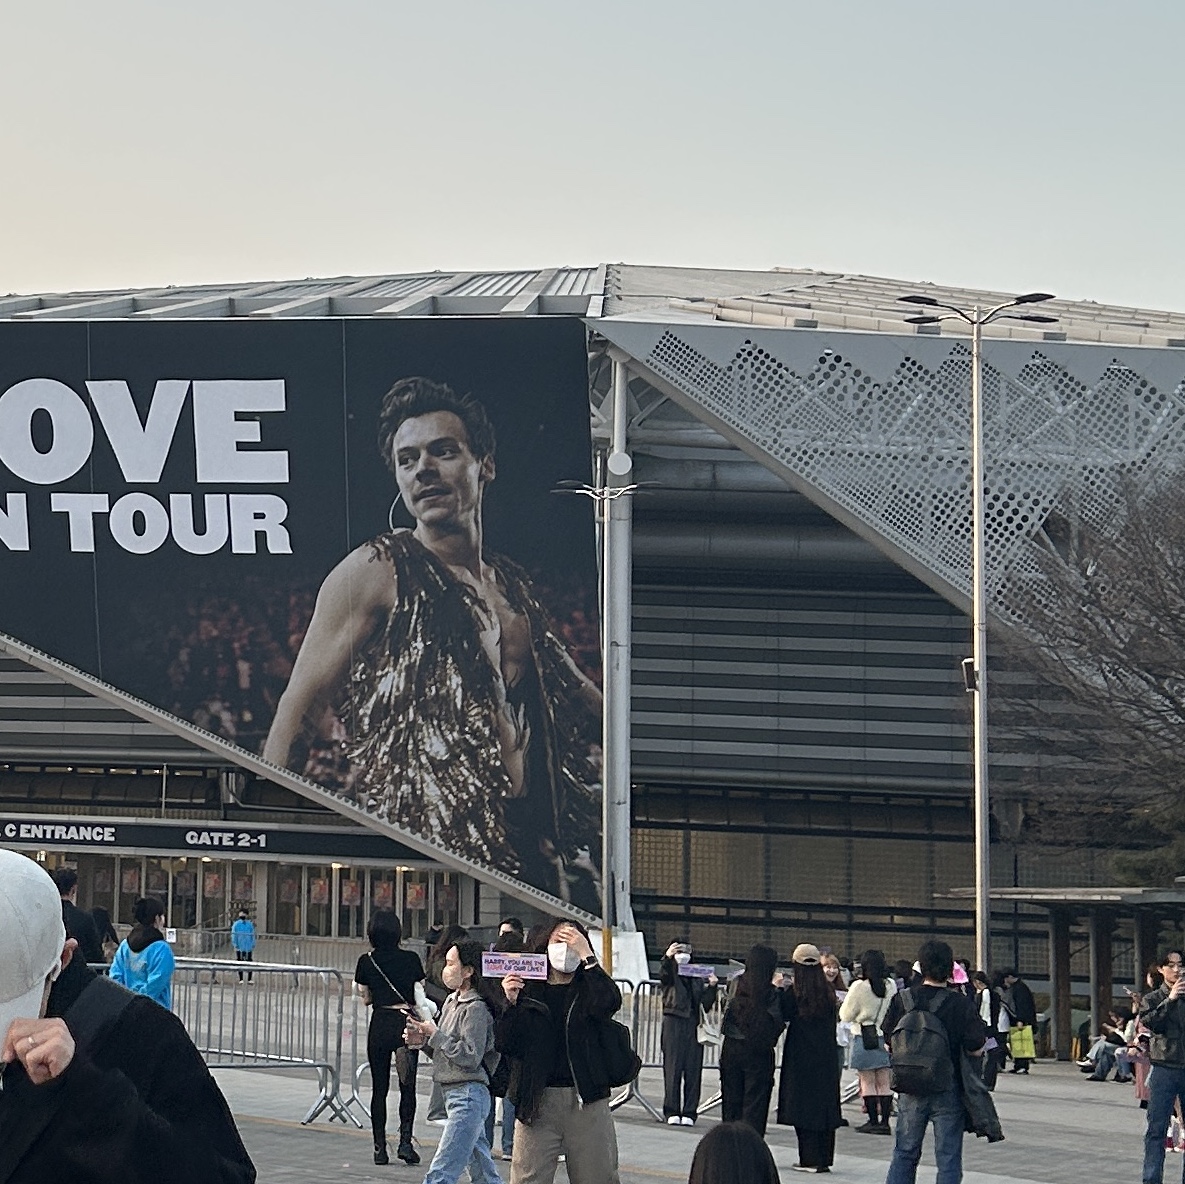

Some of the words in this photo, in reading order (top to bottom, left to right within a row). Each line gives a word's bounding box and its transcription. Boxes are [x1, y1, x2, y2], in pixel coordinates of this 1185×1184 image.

[51, 492, 293, 555] TOUR
[4, 823, 17, 838] C
[19, 824, 116, 841] ENTRANCE
[185, 831, 235, 846] GATE
[237, 833, 267, 848] 2-1
